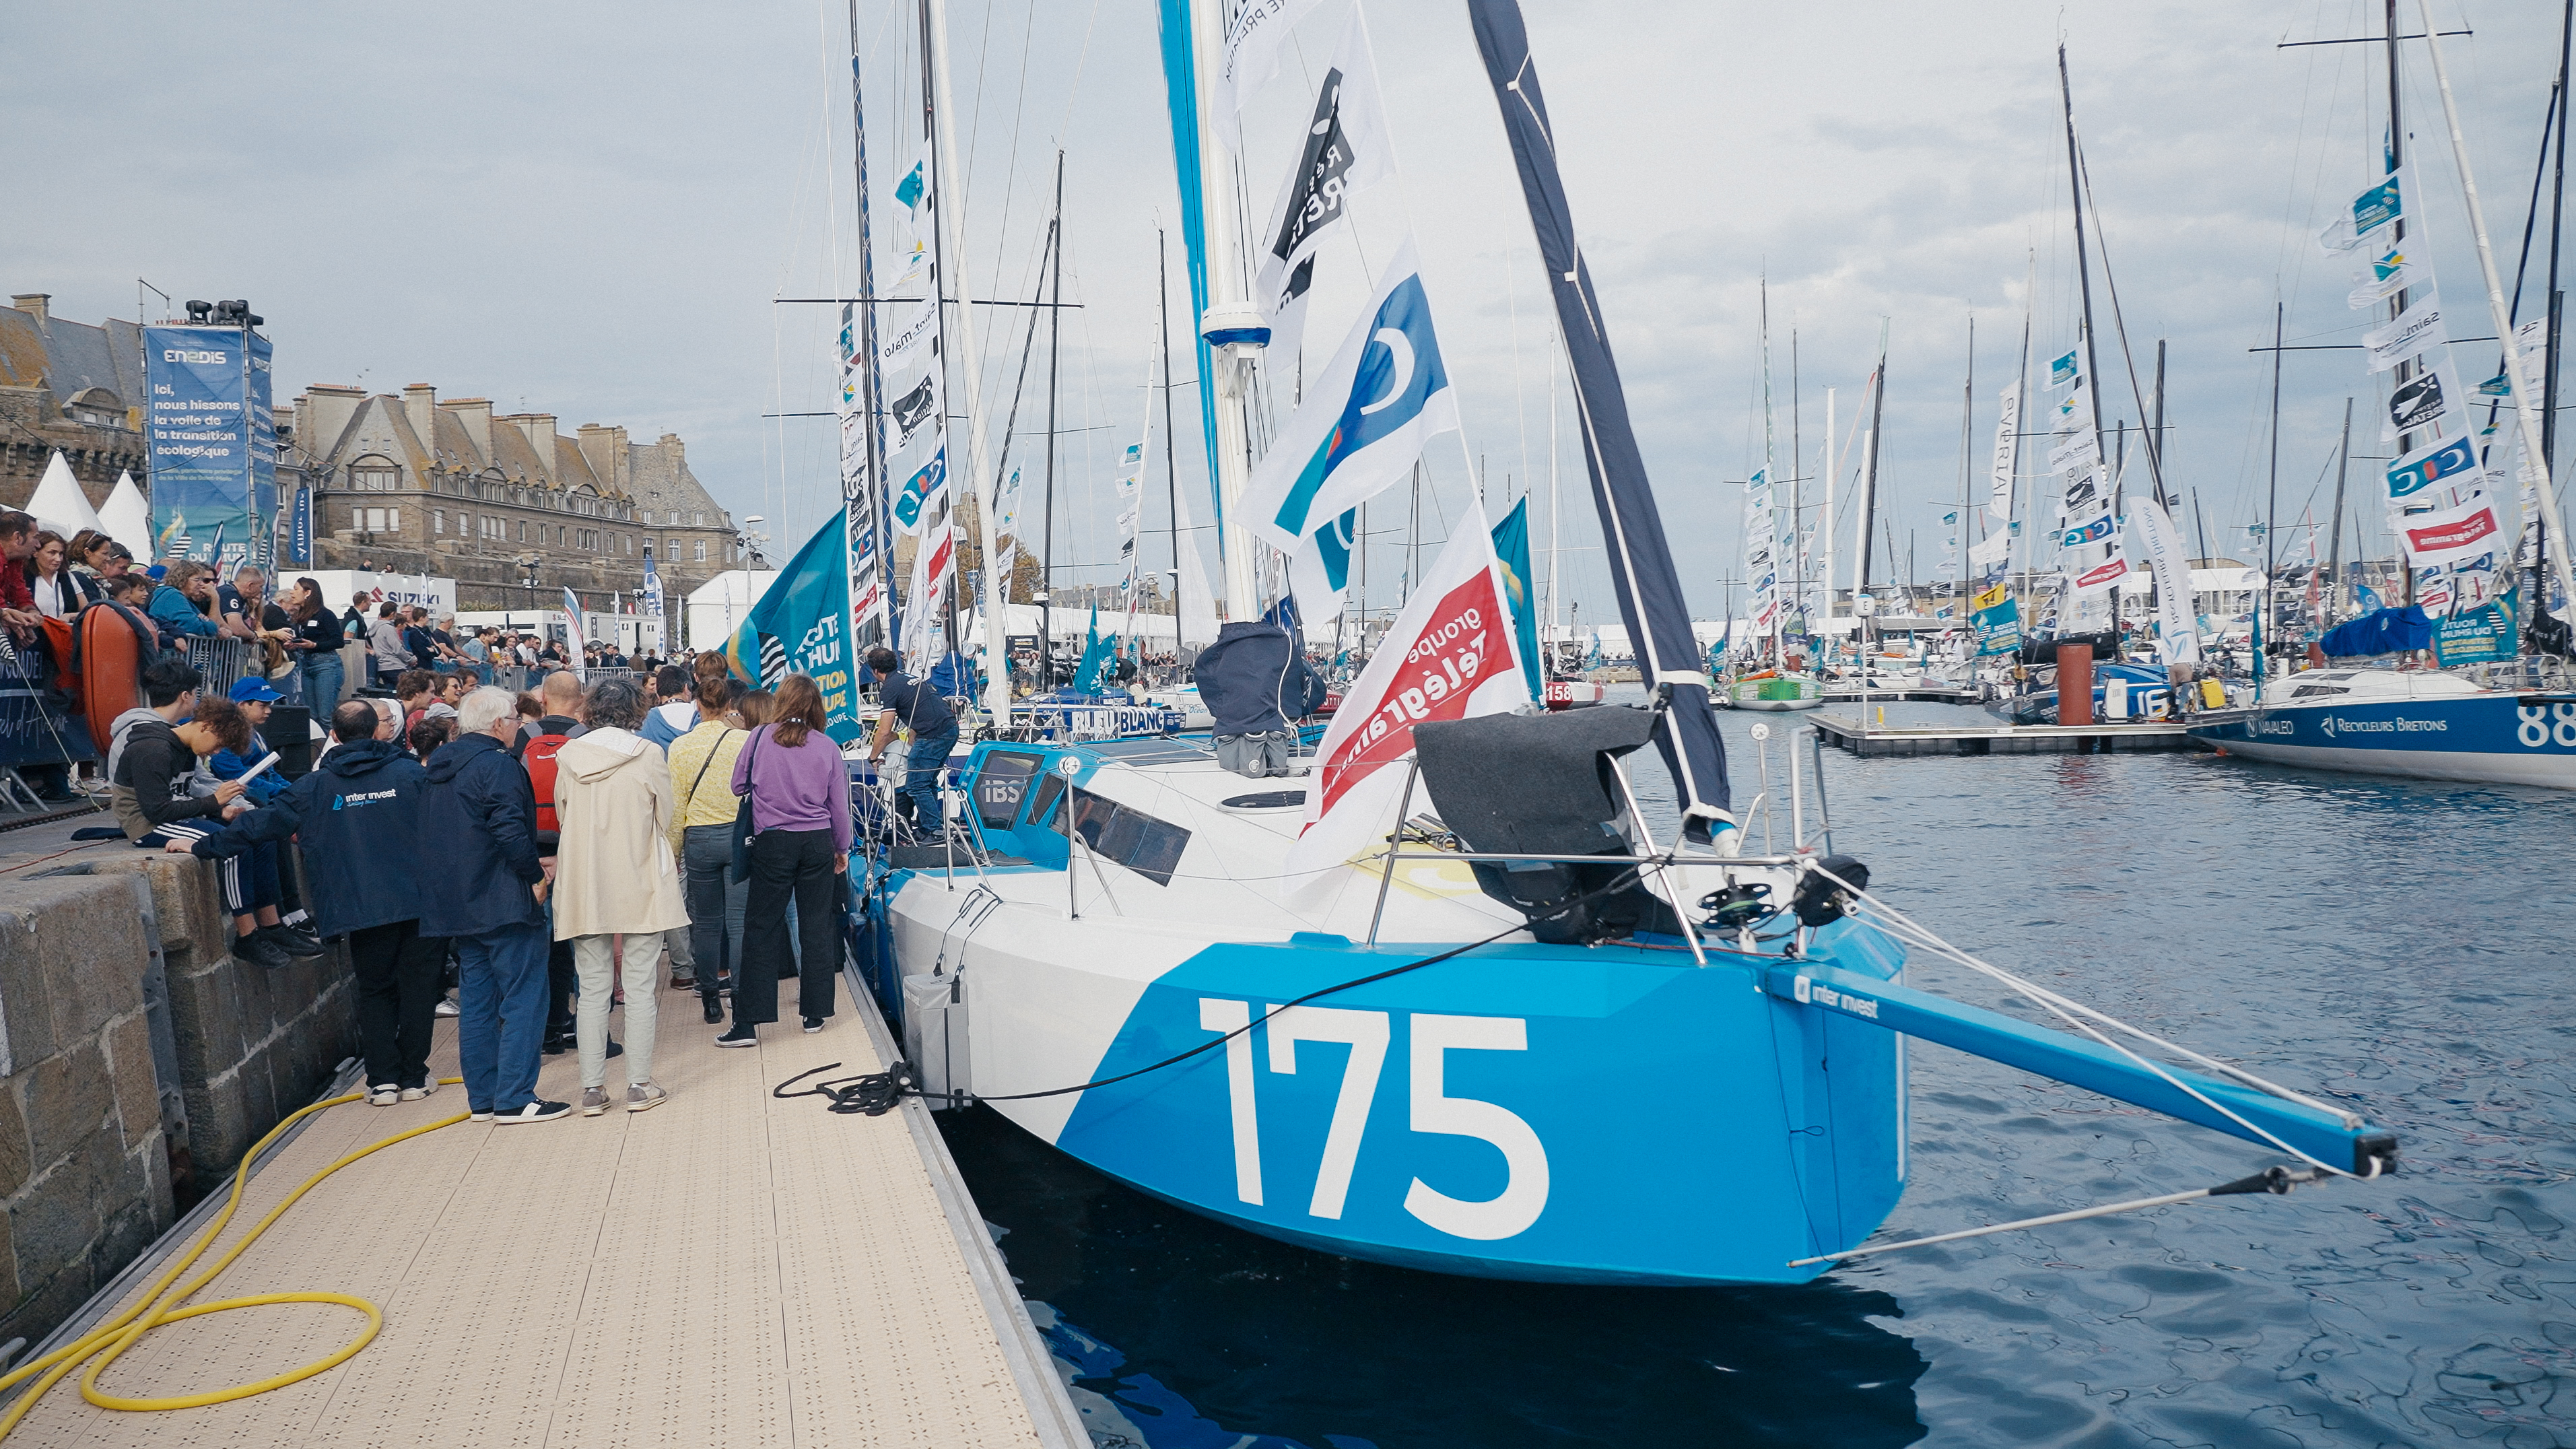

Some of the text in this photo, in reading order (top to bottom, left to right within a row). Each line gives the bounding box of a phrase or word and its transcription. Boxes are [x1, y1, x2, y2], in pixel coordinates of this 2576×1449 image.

[154, 383, 175, 397] Ici,
[154, 399, 240, 411] nous hissons
[154, 415, 222, 426] la voile de
[154, 429, 237, 441] la transition
[156, 444, 230, 459] écologique
[203, 543, 246, 552] RUTE
[230, 599, 239, 609] 6
[1547, 685, 1571, 701] 158
[1120, 712, 1163, 733] BLANC
[2258, 720, 2294, 735] NAVALEO
[2337, 716, 2448, 733] RECYCLEURS BRETONS
[2517, 703, 2576, 747] 88
[345, 788, 397, 803] inter invest
[985, 779, 1020, 803] IBS
[1812, 984, 1878, 1019] inter invest
[1198, 997, 1550, 1241] 175
